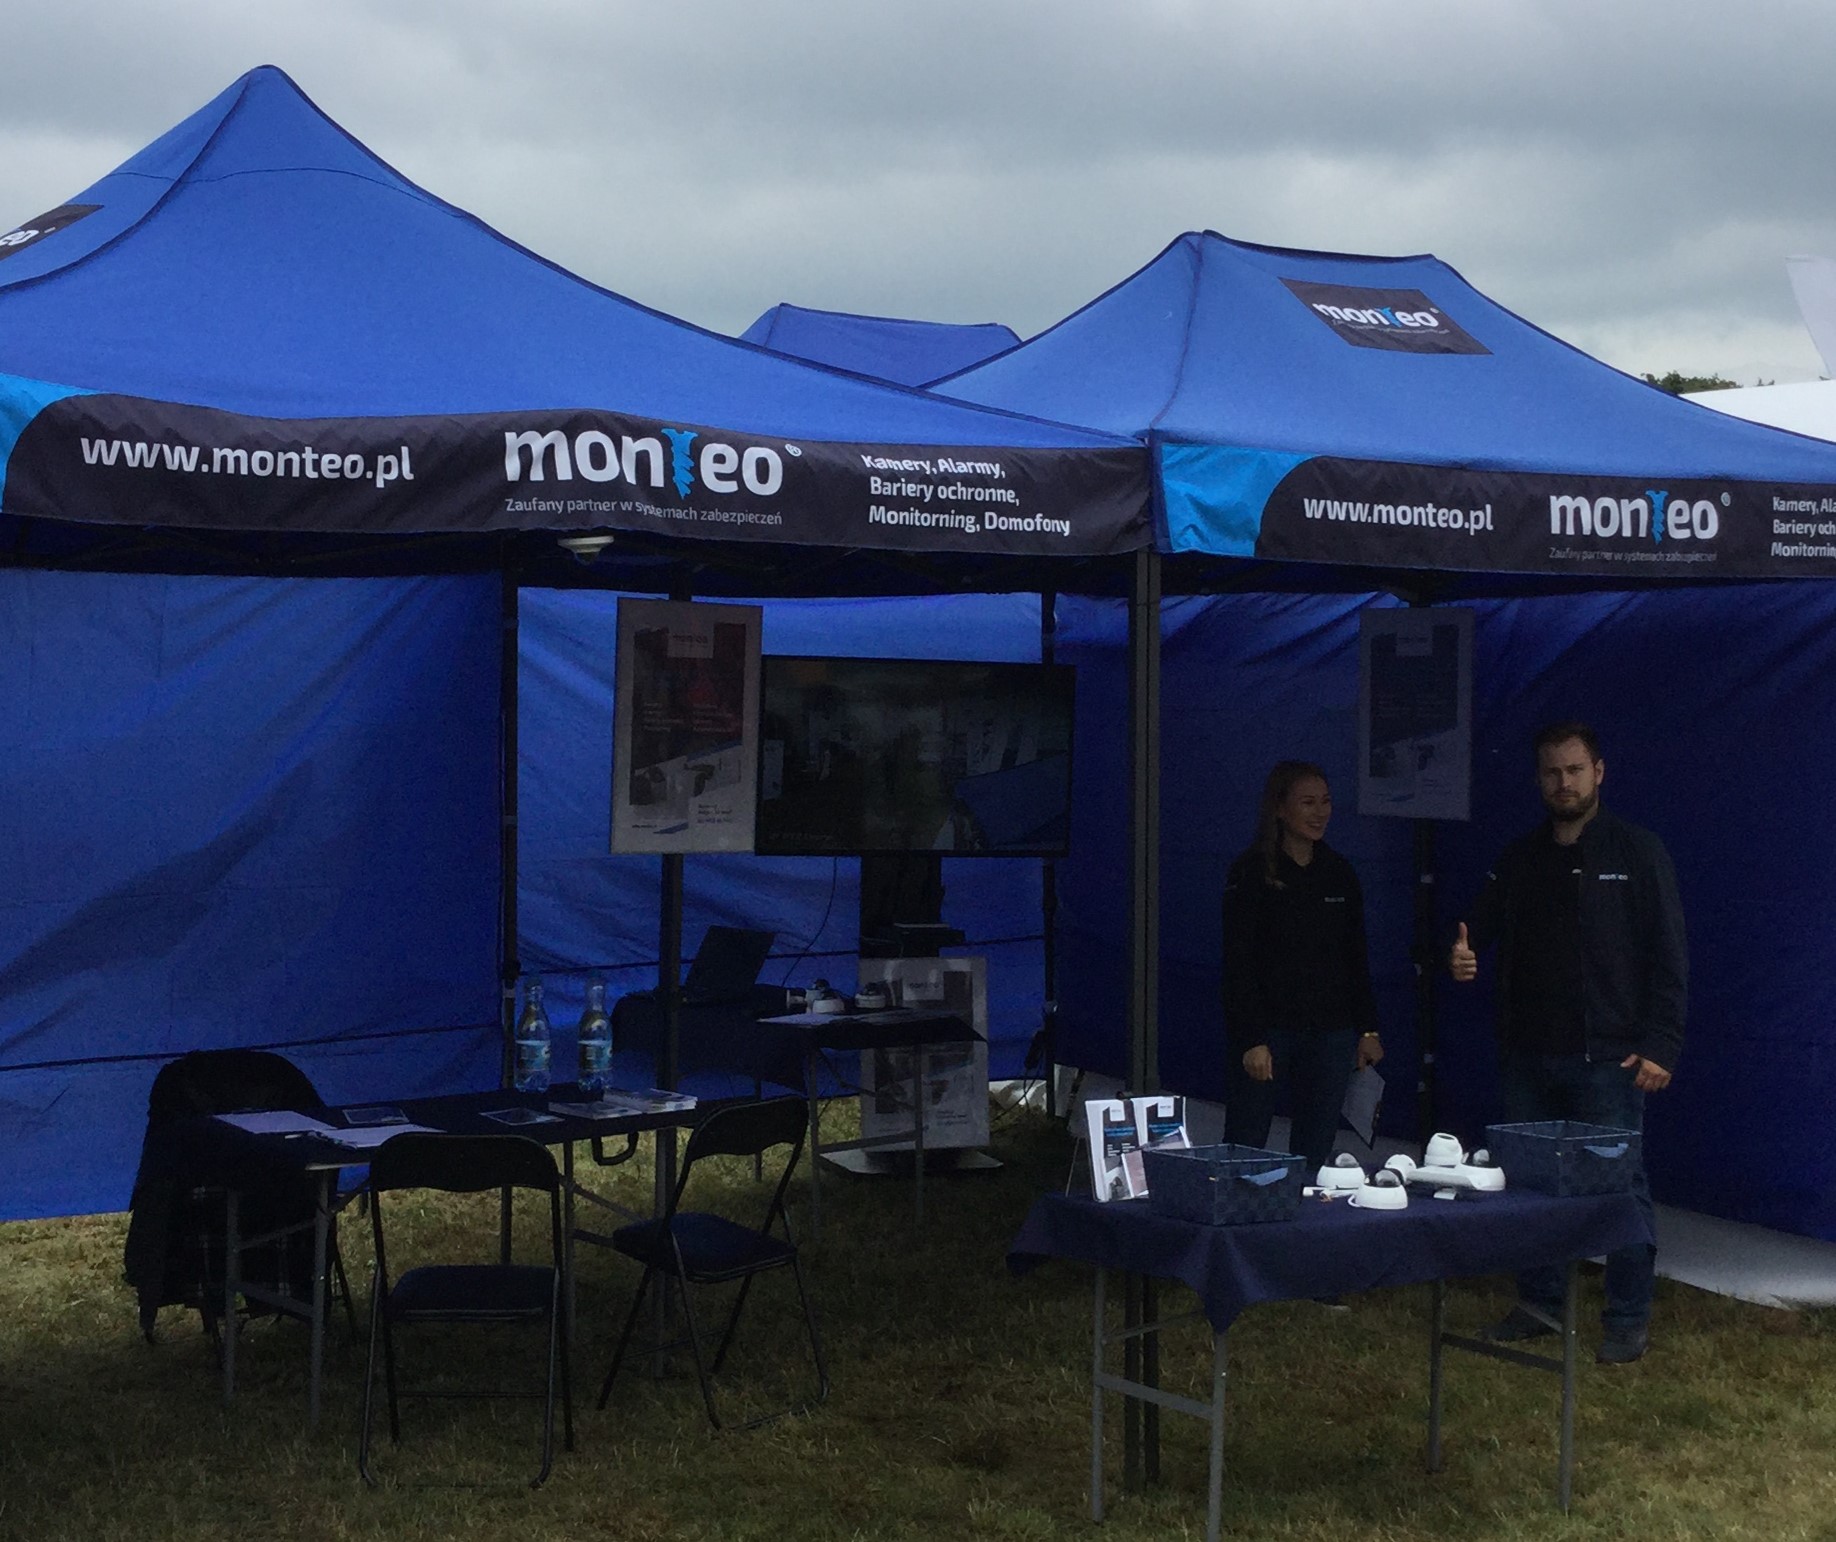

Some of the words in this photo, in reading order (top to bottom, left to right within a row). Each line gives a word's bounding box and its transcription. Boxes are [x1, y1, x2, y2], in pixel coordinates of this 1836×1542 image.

[1312, 303, 1439, 327] monteo
[80, 436, 415, 488] www.monteo.pl
[505, 428, 783, 499] monteo
[861, 454, 938, 476] Kamery,
[938, 457, 1007, 479] Alarmy,
[869, 476, 934, 502] Bariery
[937, 482, 1020, 506] ochronne,
[1772, 496, 1819, 515] Kamery,
[506, 497, 563, 514] Zaufany
[567, 498, 617, 513] partner
[620, 501, 633, 512] w
[700, 509, 782, 526] zabezpieczeń
[868, 505, 981, 533] Monitorning,
[984, 511, 1071, 536] Domofony
[1303, 498, 1494, 536] www.monteo.pl
[1549, 490, 1719, 545] monteo
[1773, 519, 1817, 538] Bariery
